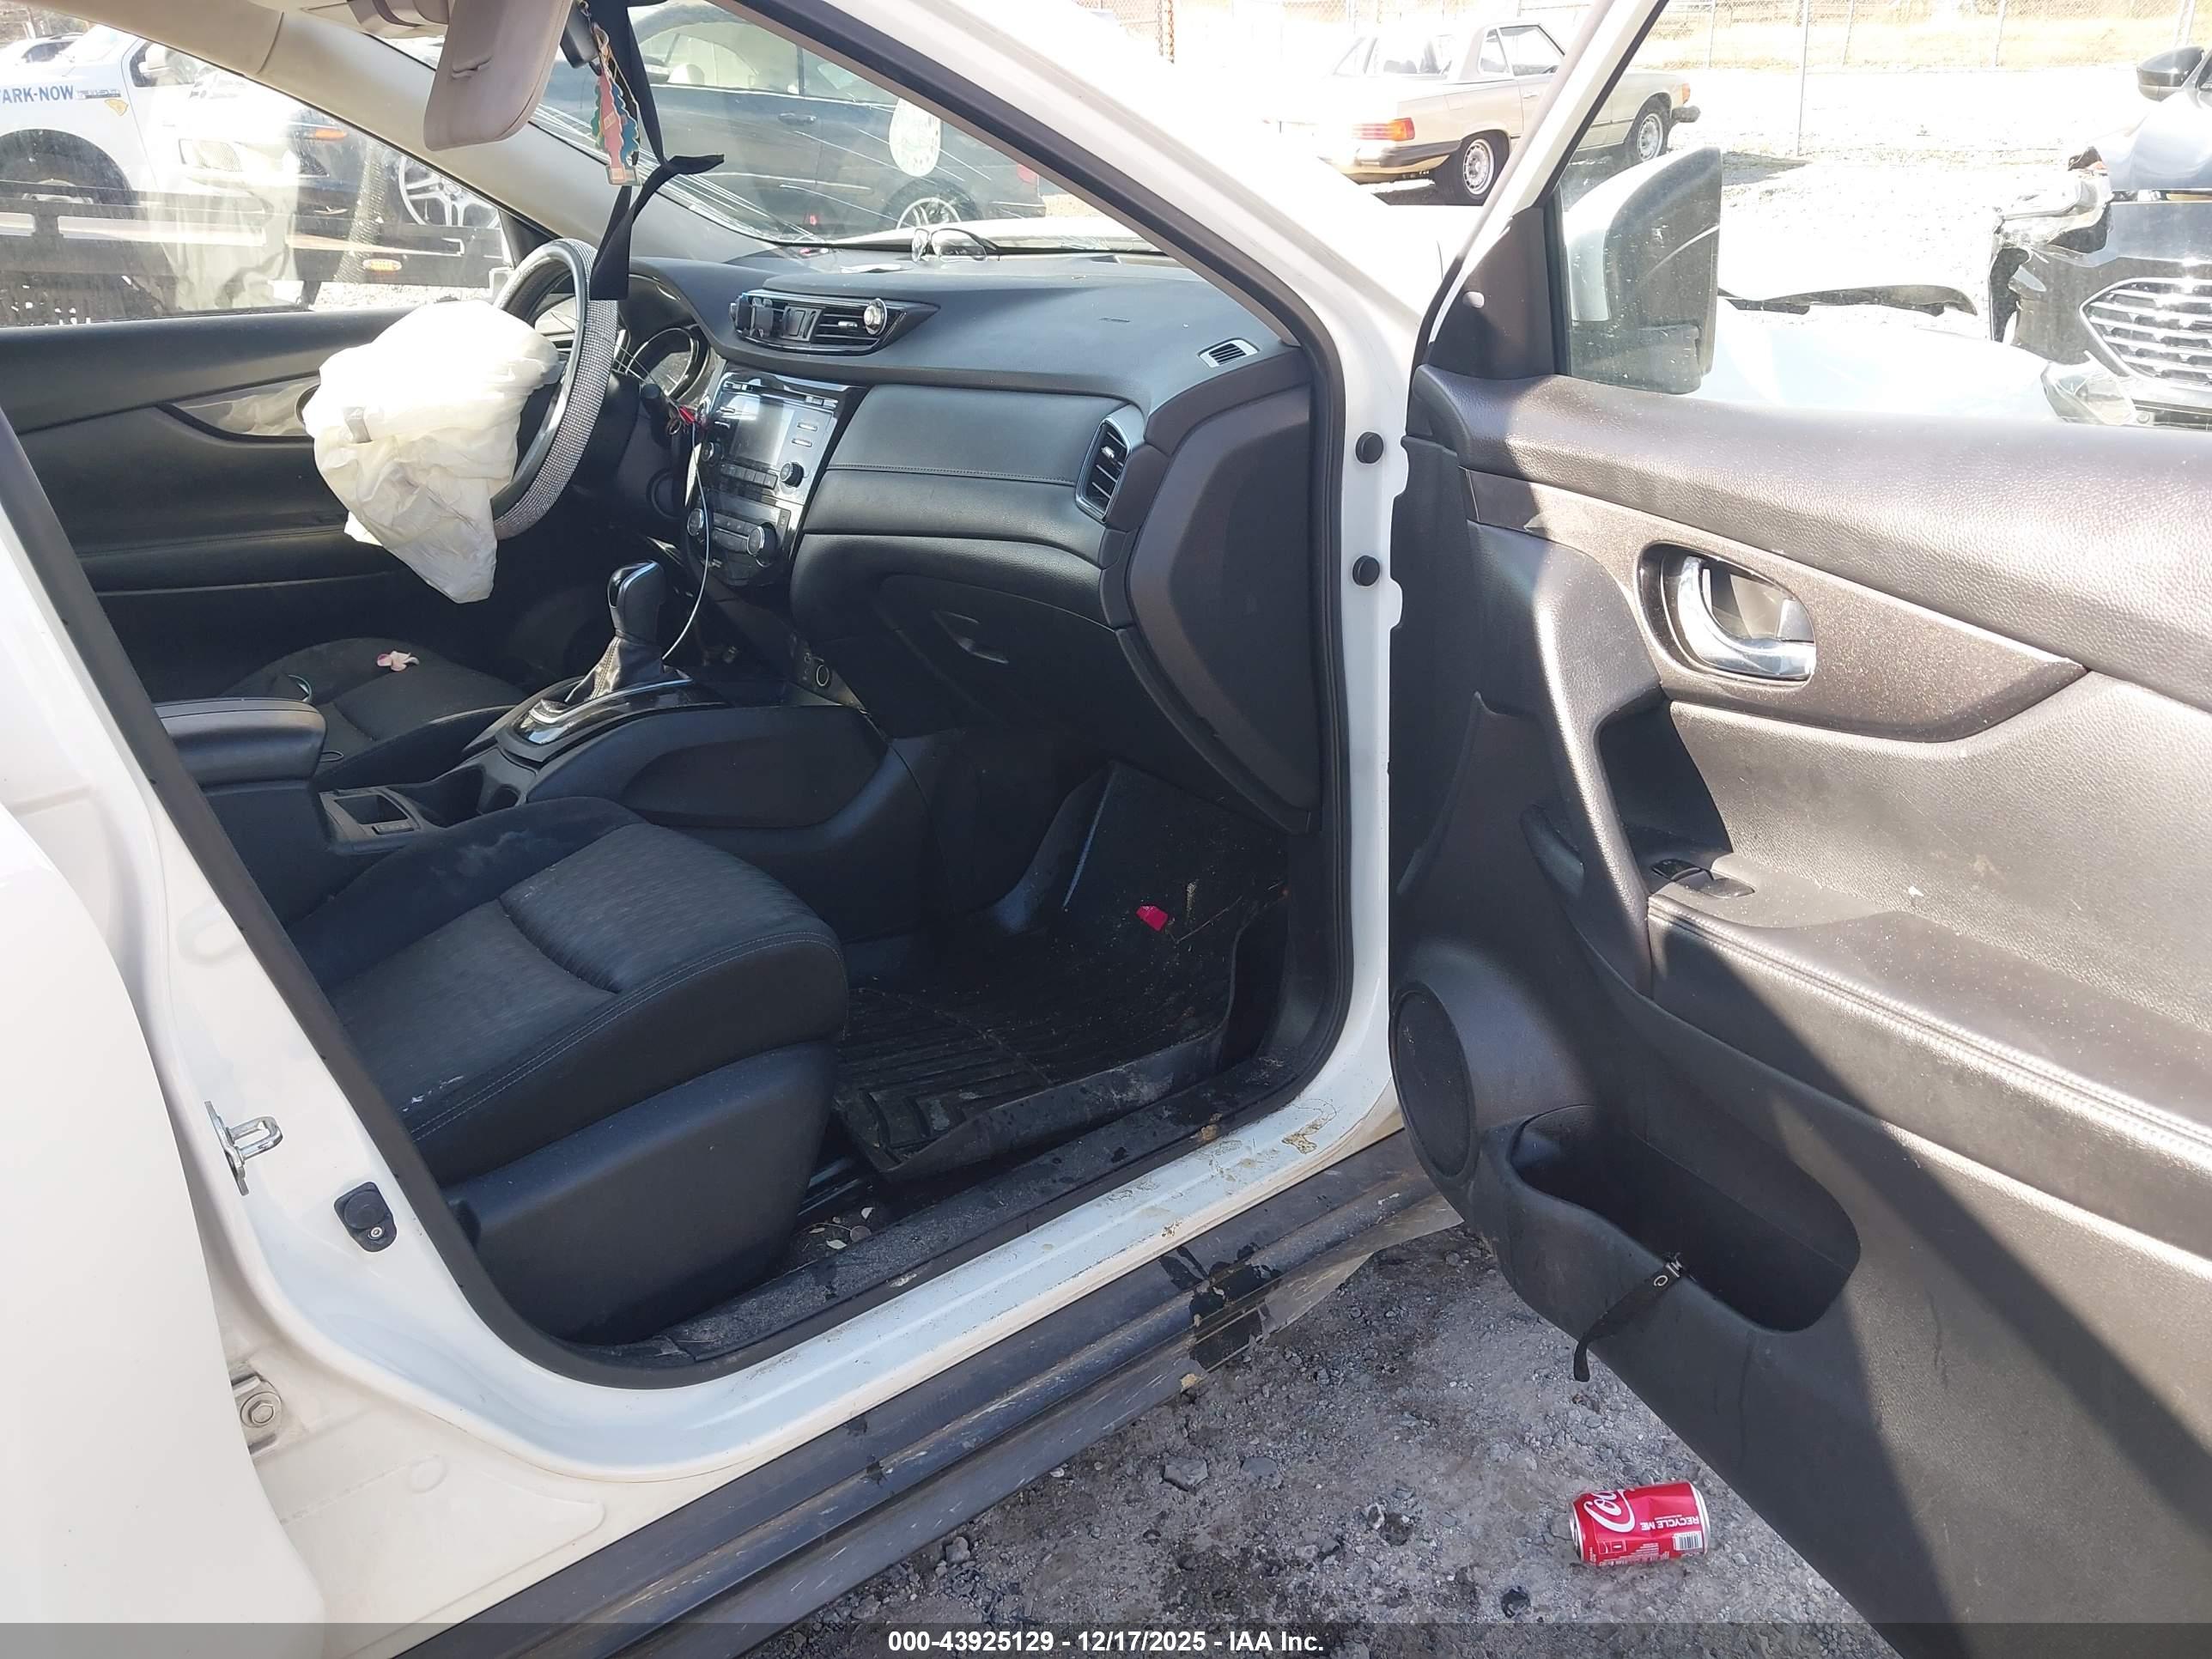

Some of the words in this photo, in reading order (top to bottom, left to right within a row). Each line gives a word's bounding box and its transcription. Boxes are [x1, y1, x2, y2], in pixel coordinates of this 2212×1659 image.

[0, 84, 74, 103] ARK-NOW
[1639, 1521, 1656, 1531] ME
[1656, 1516, 1699, 1529] RECYCLE
